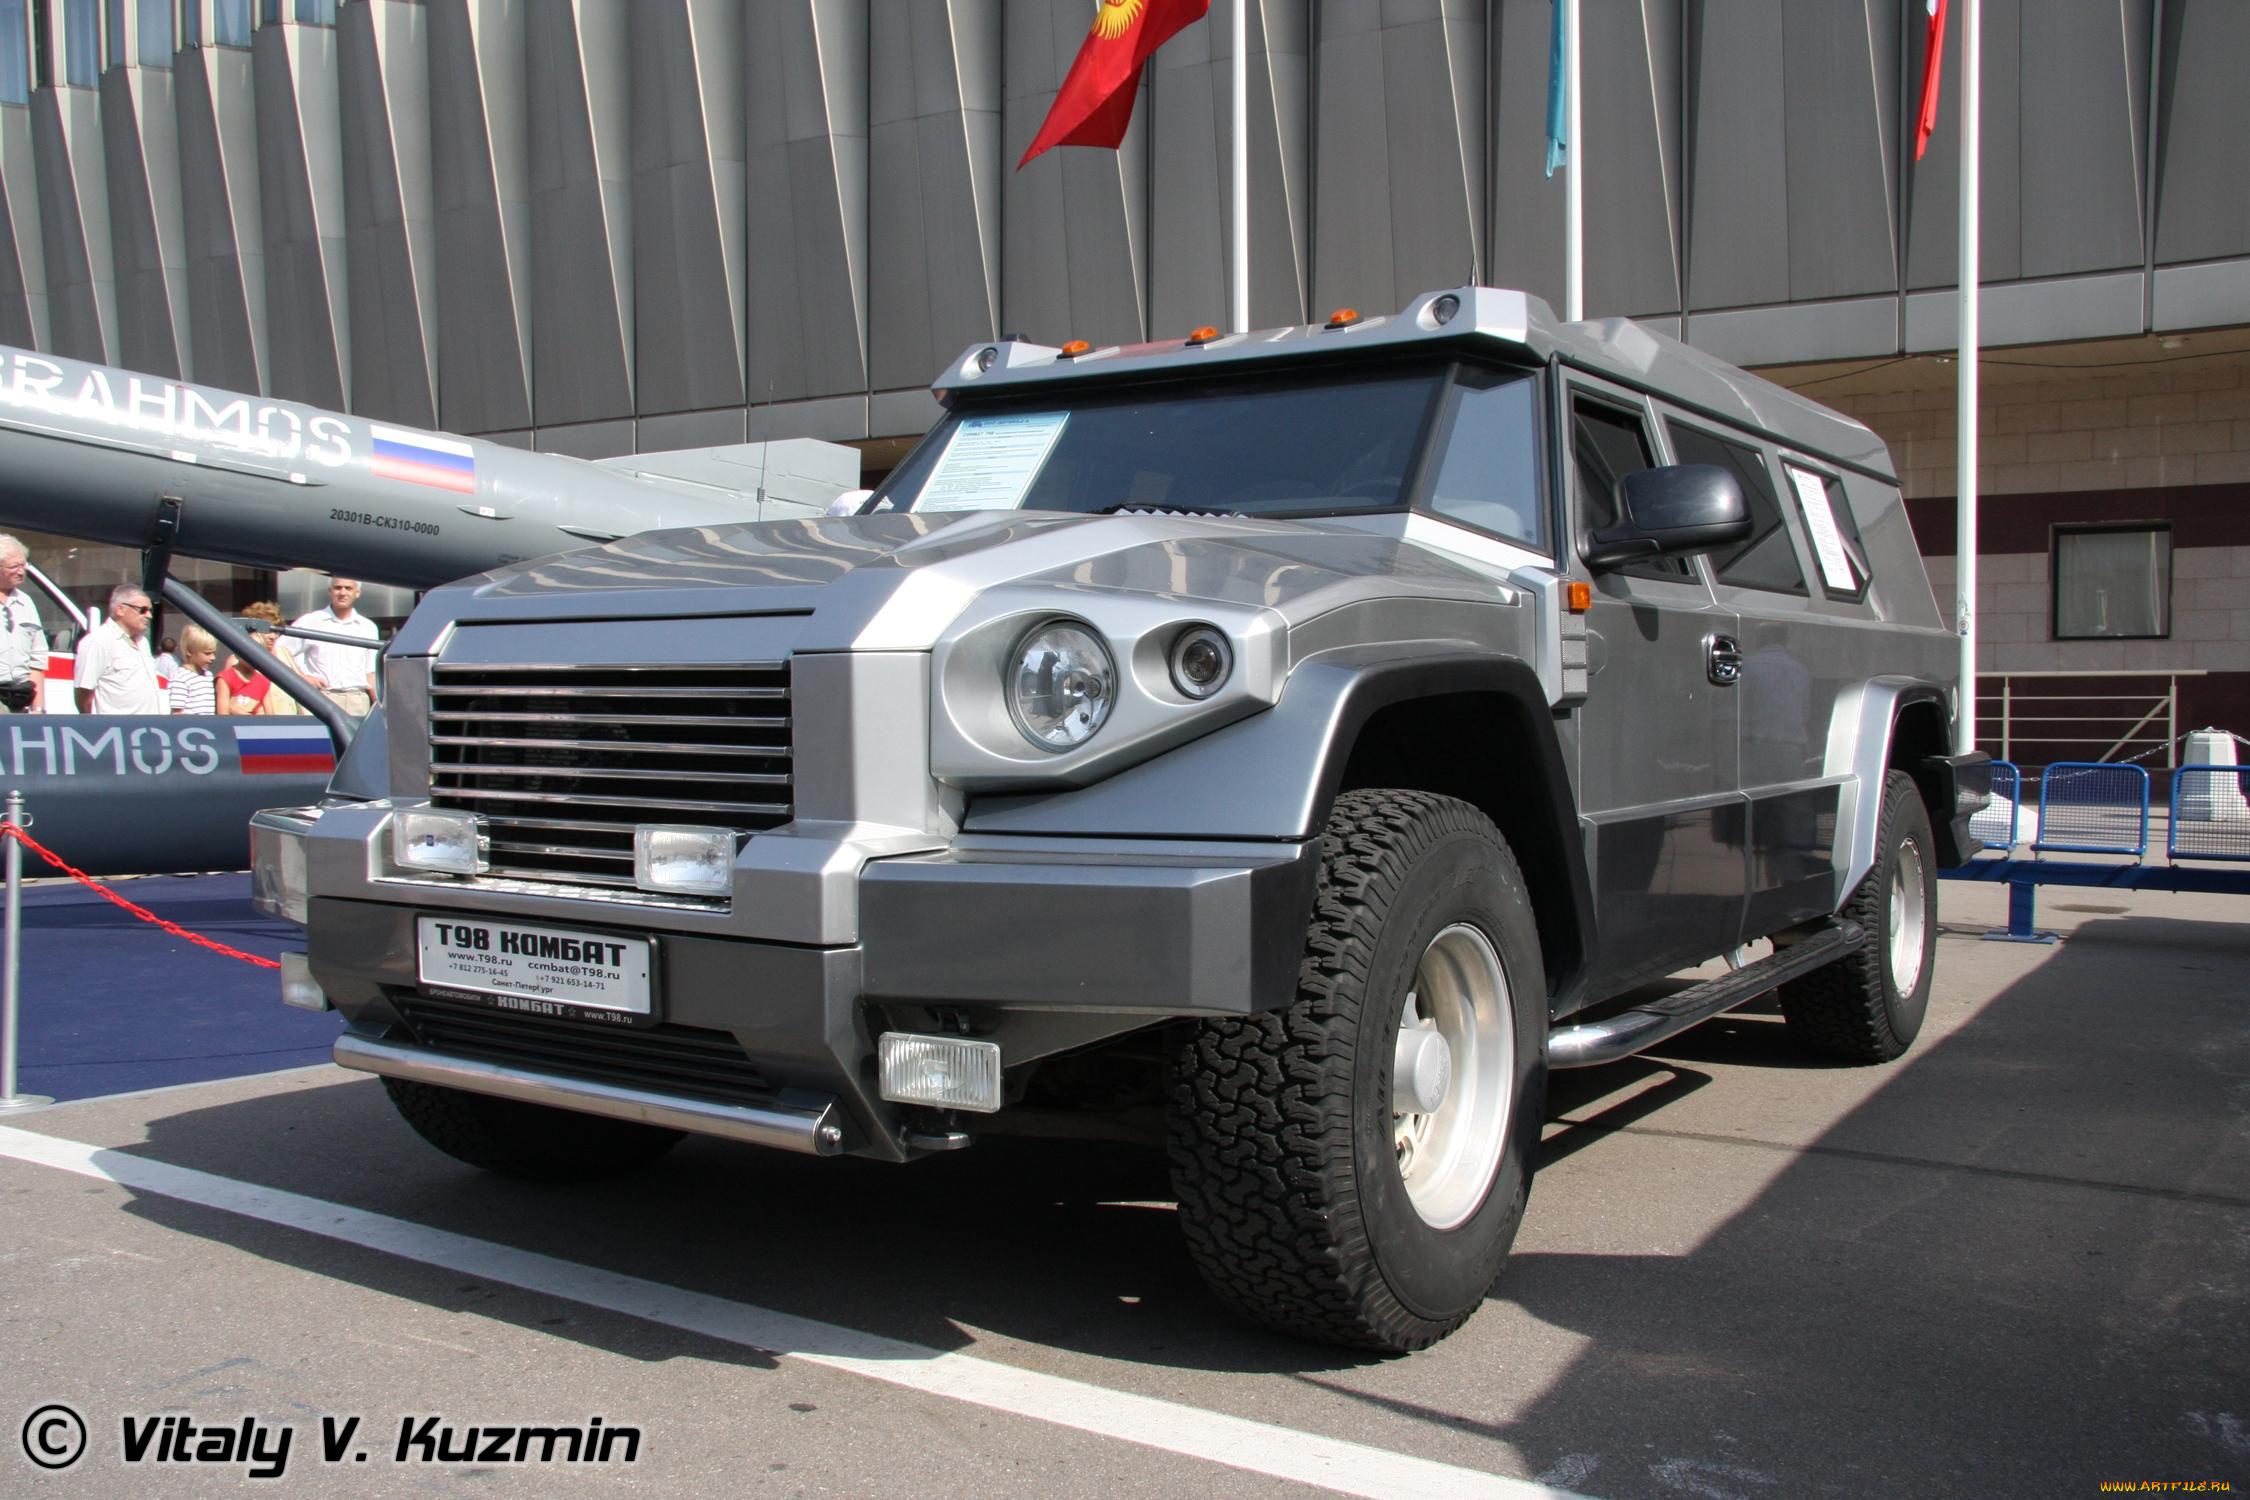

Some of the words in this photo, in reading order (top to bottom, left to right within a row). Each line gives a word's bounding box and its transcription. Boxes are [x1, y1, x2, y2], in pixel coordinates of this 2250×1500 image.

[0, 725, 219, 775] HMOS
[500, 931, 627, 967] КОМБАТ
[448, 951, 513, 966] www.T98.ru
[551, 976, 565, 985] 921
[566, 978, 605, 990] 653-14-71
[497, 996, 565, 1016] КОМБАТ
[584, 1010, 633, 1024] www.T98.ru
